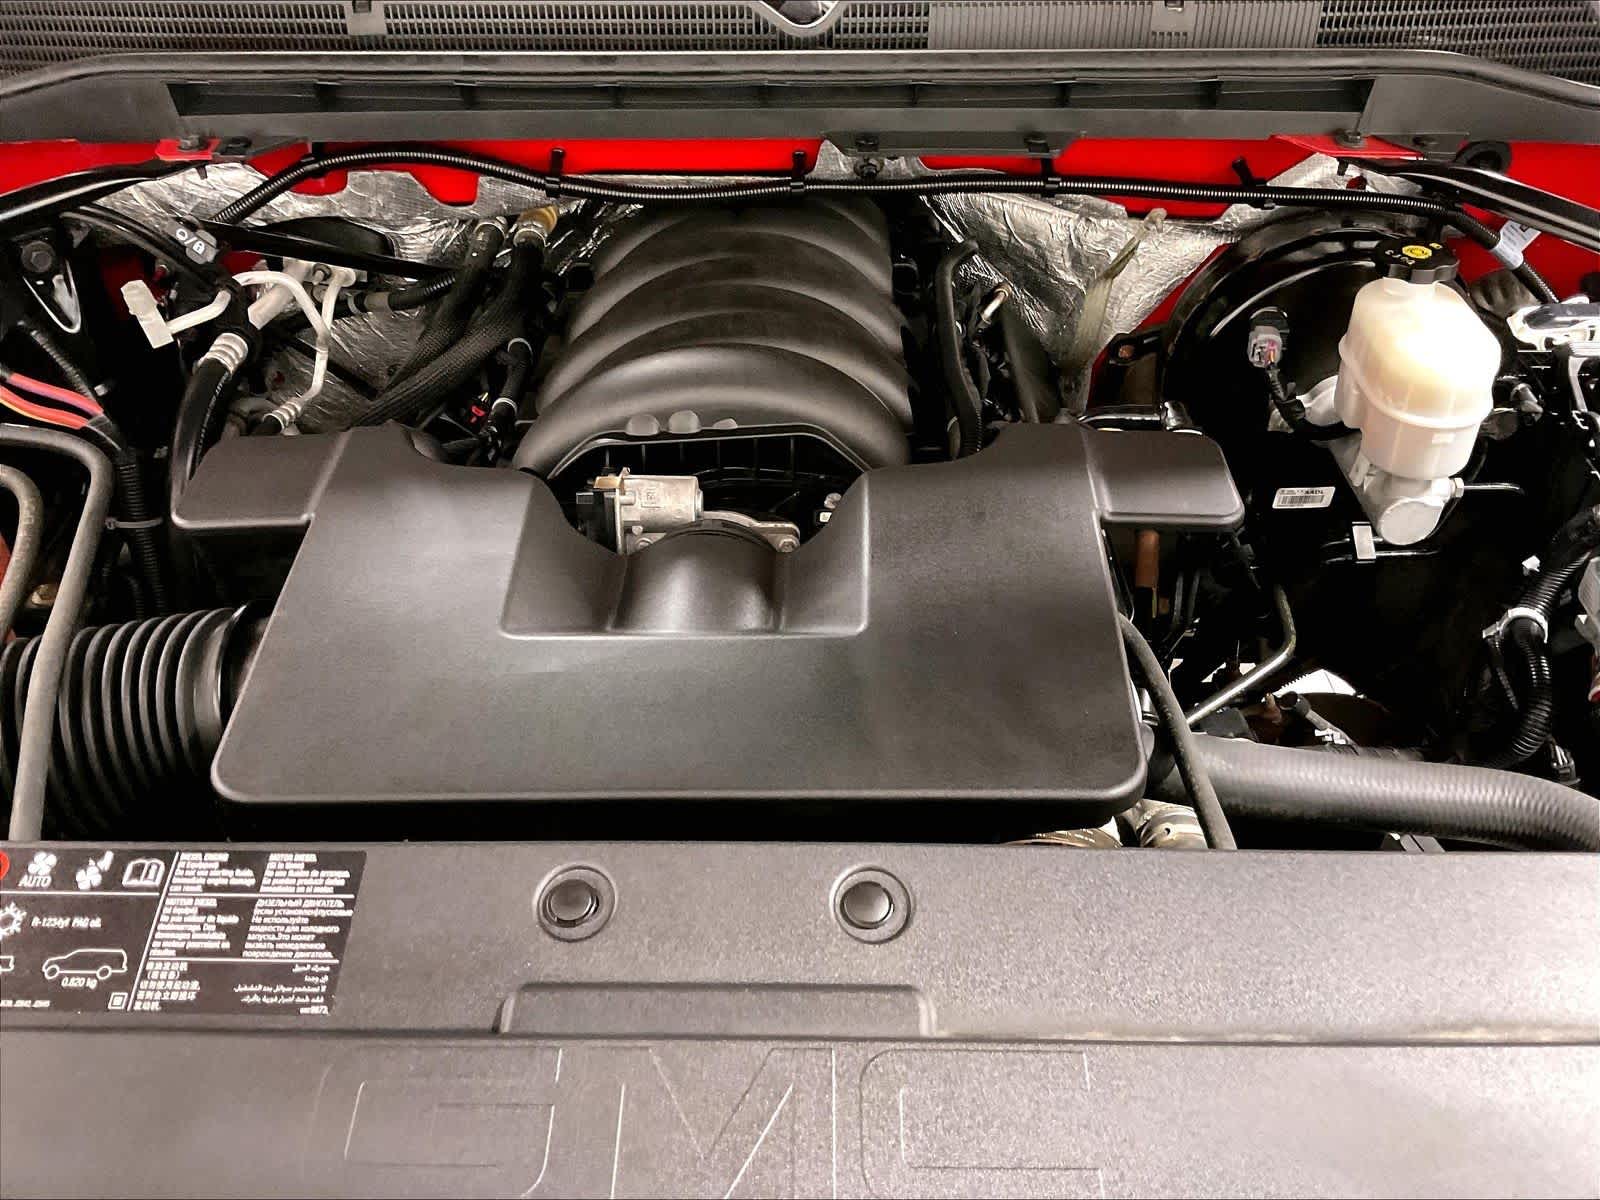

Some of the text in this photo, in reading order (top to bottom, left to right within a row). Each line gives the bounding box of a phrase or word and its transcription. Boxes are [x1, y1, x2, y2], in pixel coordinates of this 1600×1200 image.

[18, 874, 51, 887] AUTO
[62, 977, 97, 989] 0.820 kg
[312, 1046, 1105, 1199] GMC
